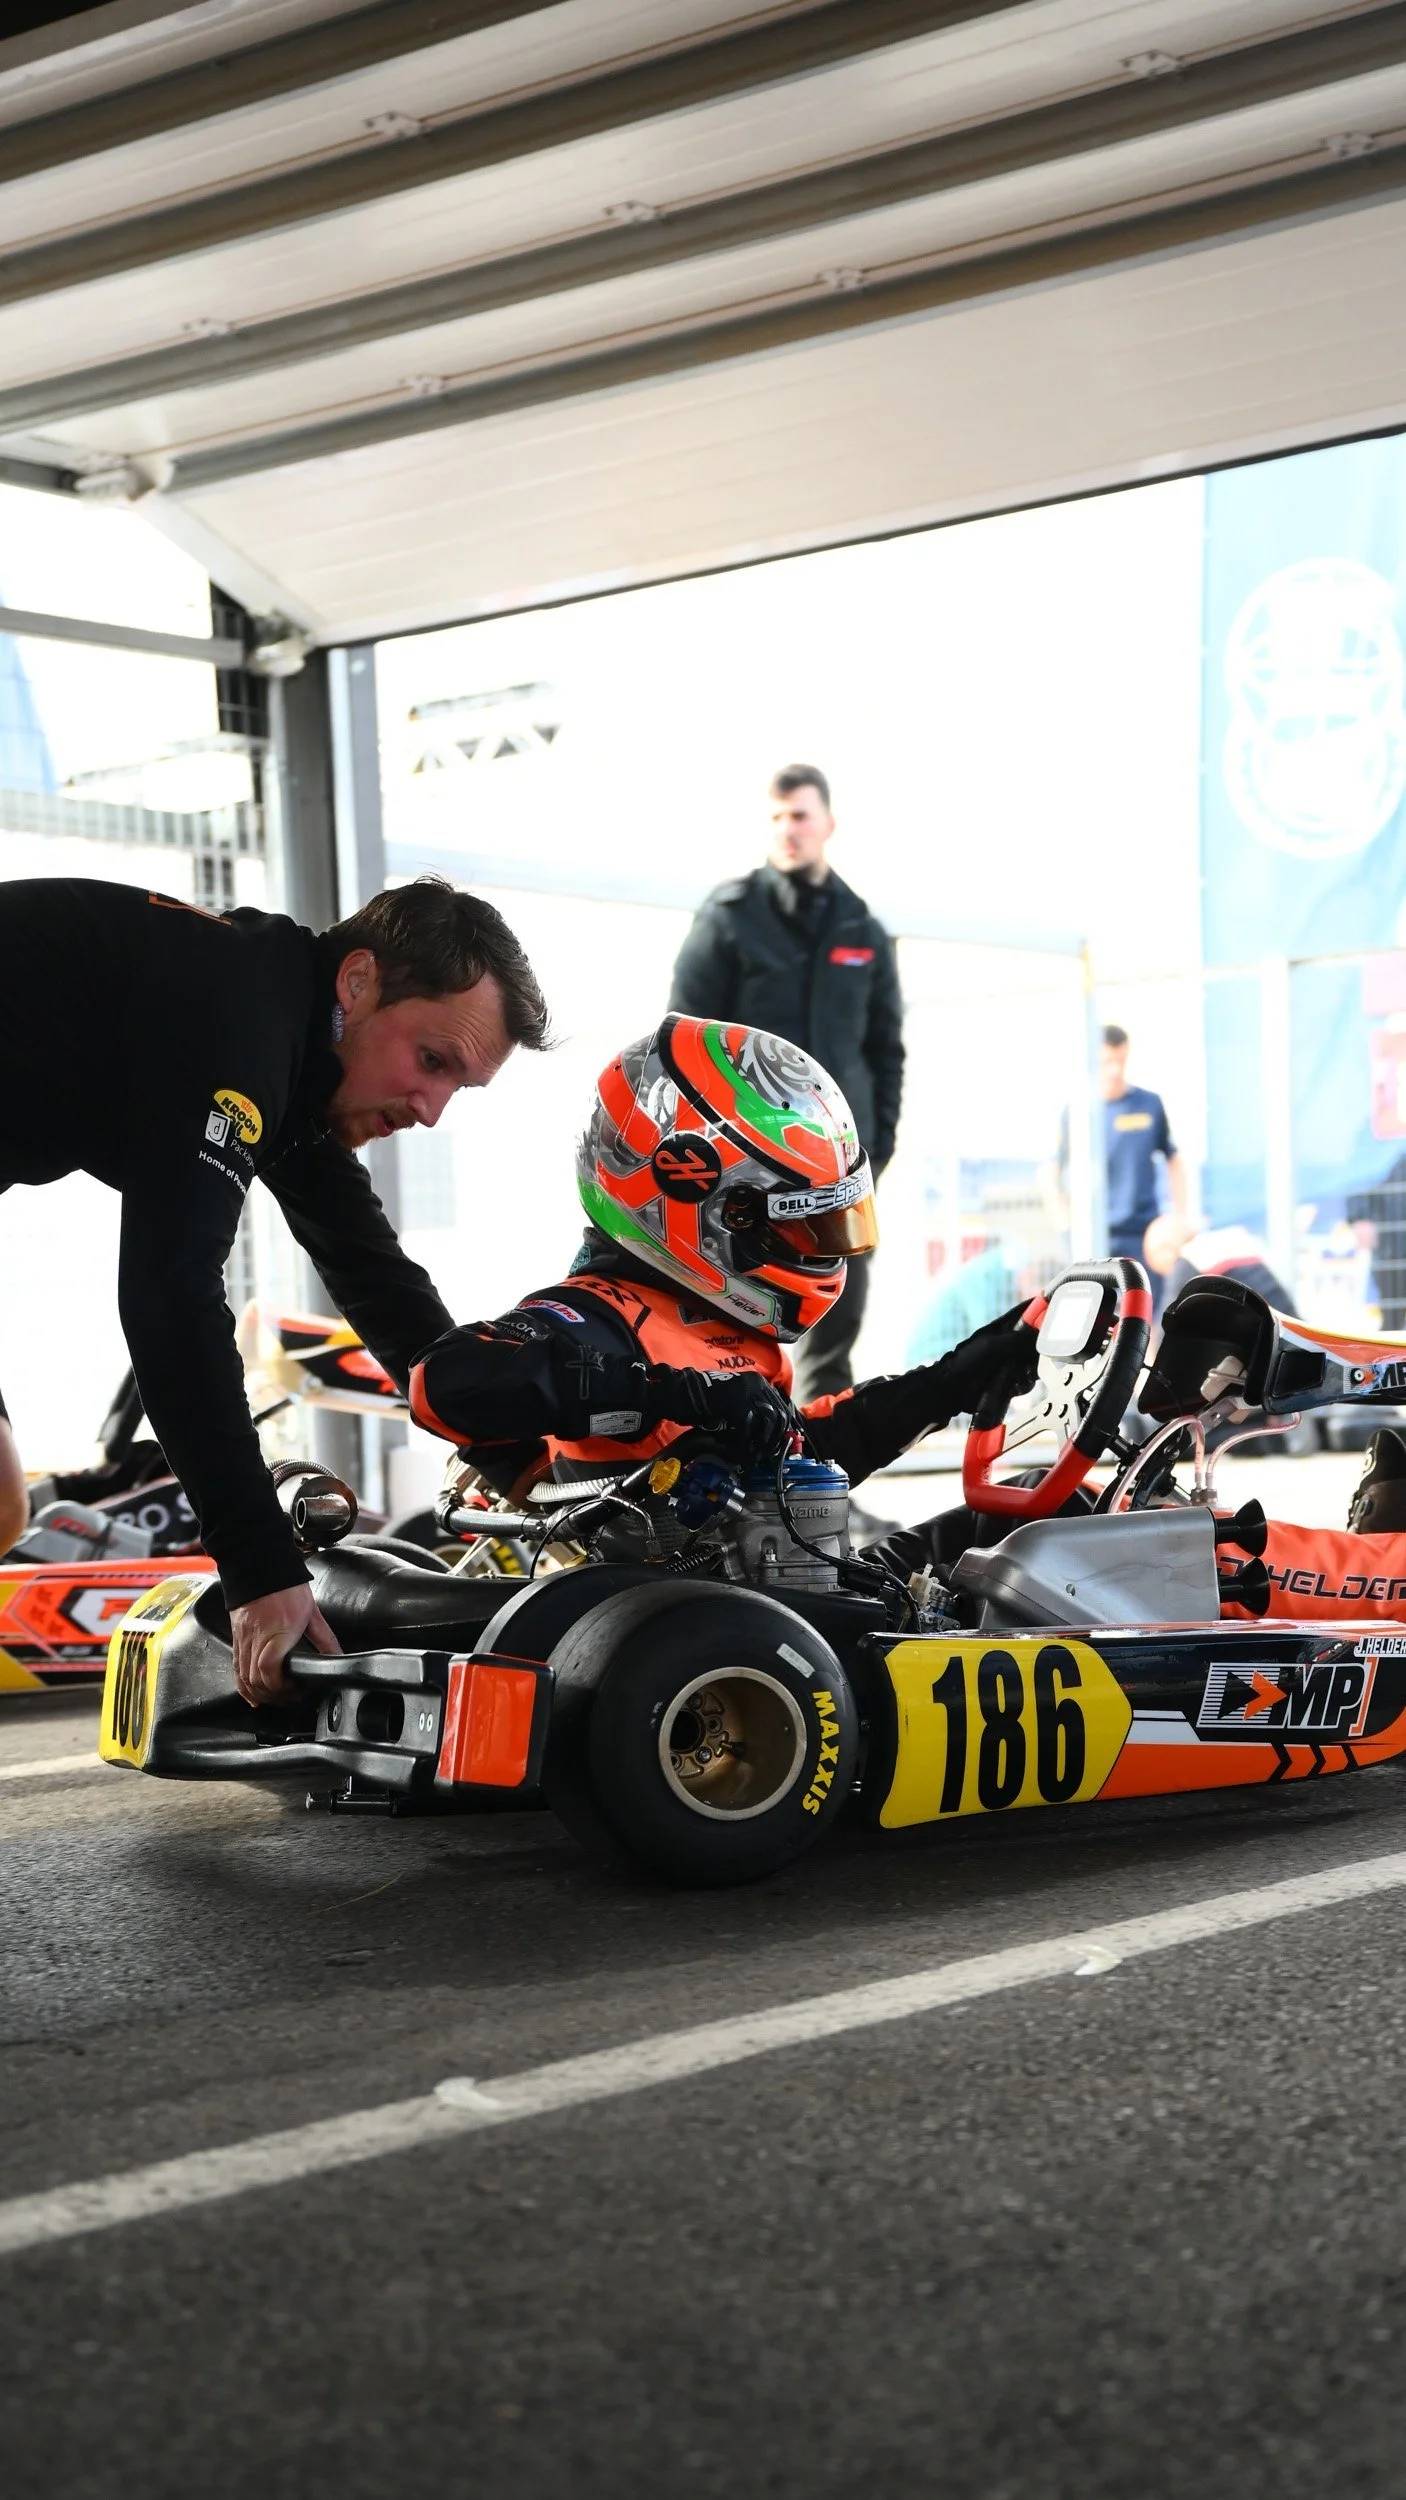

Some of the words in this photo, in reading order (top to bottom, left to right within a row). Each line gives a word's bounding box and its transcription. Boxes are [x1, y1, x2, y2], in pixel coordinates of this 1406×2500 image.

[221, 1097, 258, 1136] KROON
[199, 1150, 226, 1172] Home
[226, 1168, 235, 1179] of
[778, 1198, 813, 1211] BELL
[724, 1293, 766, 1317] Helder
[931, 1644, 1086, 1813] 186
[802, 1690, 840, 1816] MAXXIS
